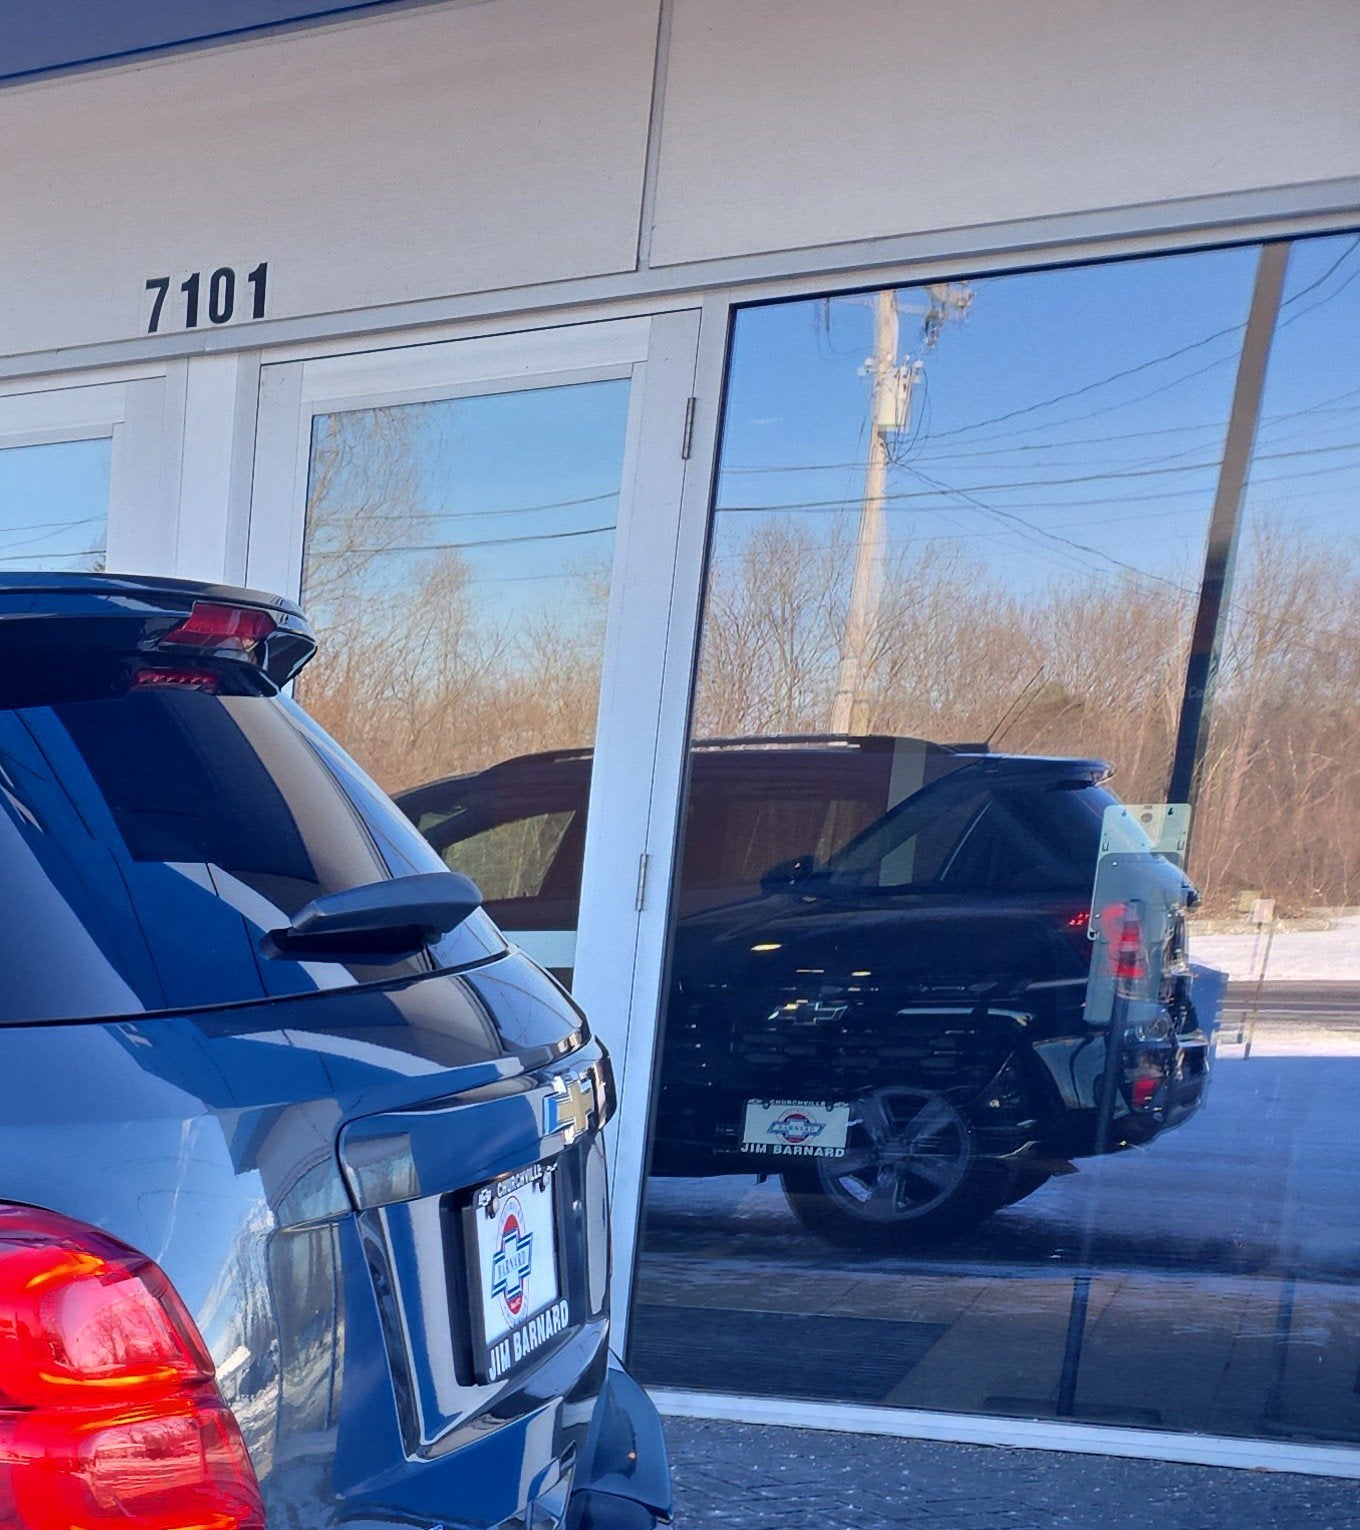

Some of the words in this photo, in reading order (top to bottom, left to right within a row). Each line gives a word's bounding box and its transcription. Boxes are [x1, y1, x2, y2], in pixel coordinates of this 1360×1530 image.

[146, 262, 268, 334] 7101
[741, 1143, 767, 1154] JIM
[773, 1145, 845, 1158] BARNARD
[489, 1338, 511, 1381] JIM
[513, 1299, 569, 1362] BARNARD
